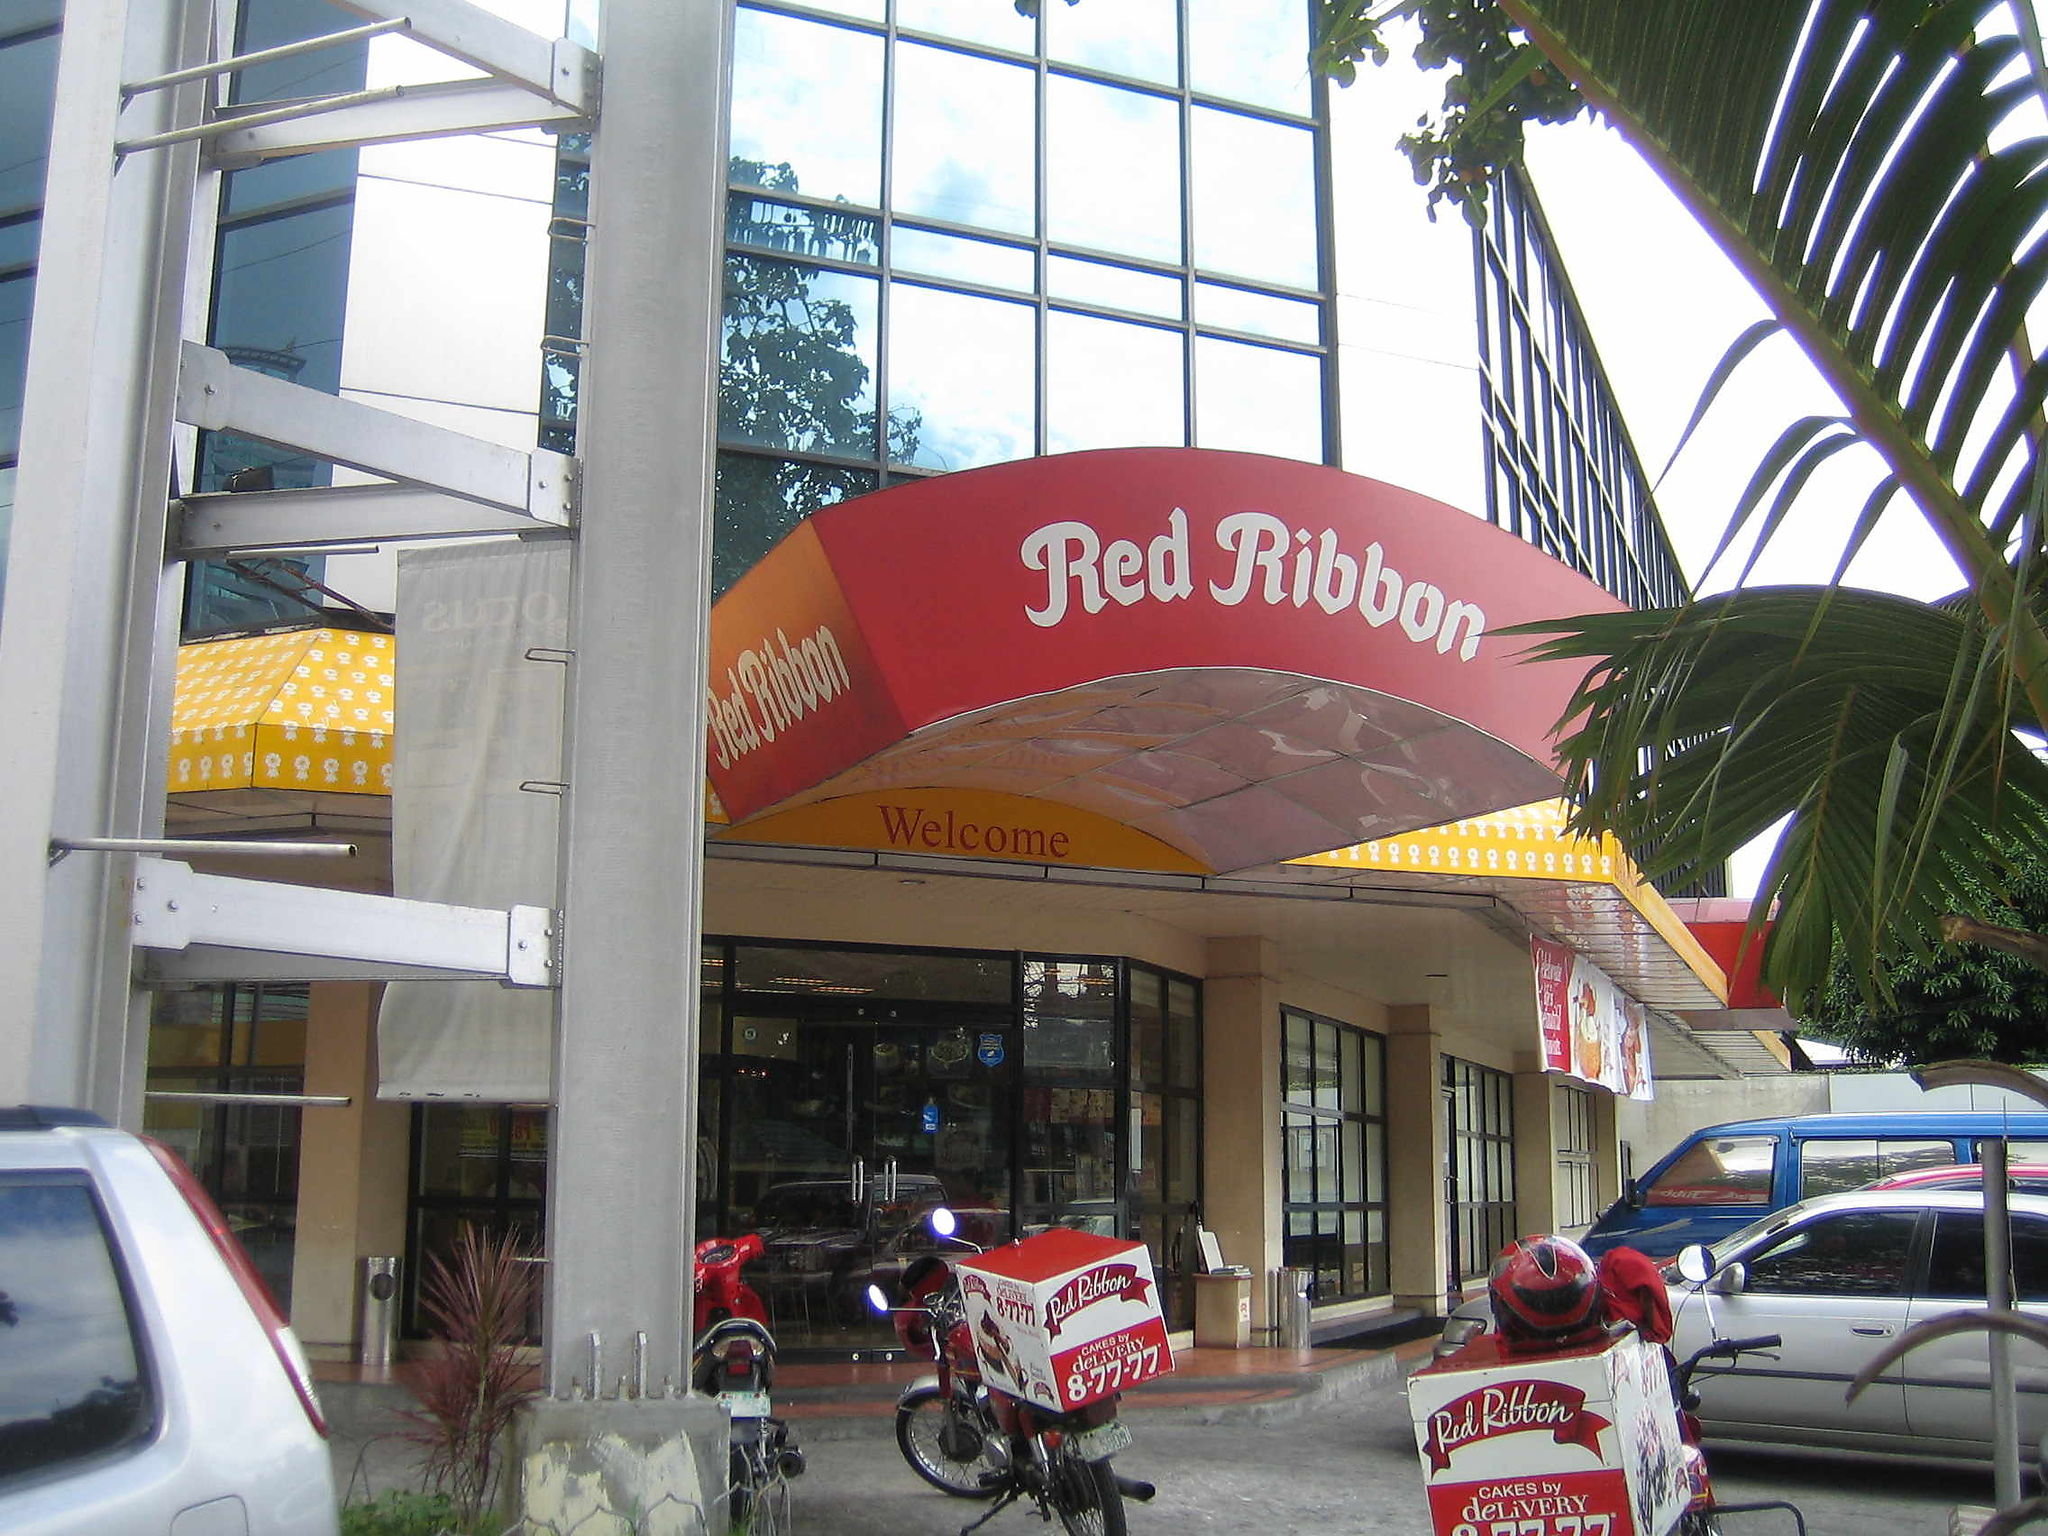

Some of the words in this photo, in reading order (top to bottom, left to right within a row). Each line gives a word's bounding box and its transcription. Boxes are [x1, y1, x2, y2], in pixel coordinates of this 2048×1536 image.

[1021, 507, 1194, 628] Red
[1209, 512, 1486, 663] Ribbon
[707, 667, 761, 770] Red
[738, 626, 850, 743] Ribbon
[876, 804, 1071, 859] Welcome
[1049, 1286, 1077, 1326] Red
[1078, 1267, 1132, 1308] Ribbon
[1081, 1337, 1116, 1356] CAKES
[1118, 1333, 1130, 1344] by
[1434, 1400, 1479, 1454] Red
[1482, 1384, 1574, 1436] Ribbon
[1478, 1483, 1538, 1500] CAKES
[1543, 1481, 1562, 1496] by
